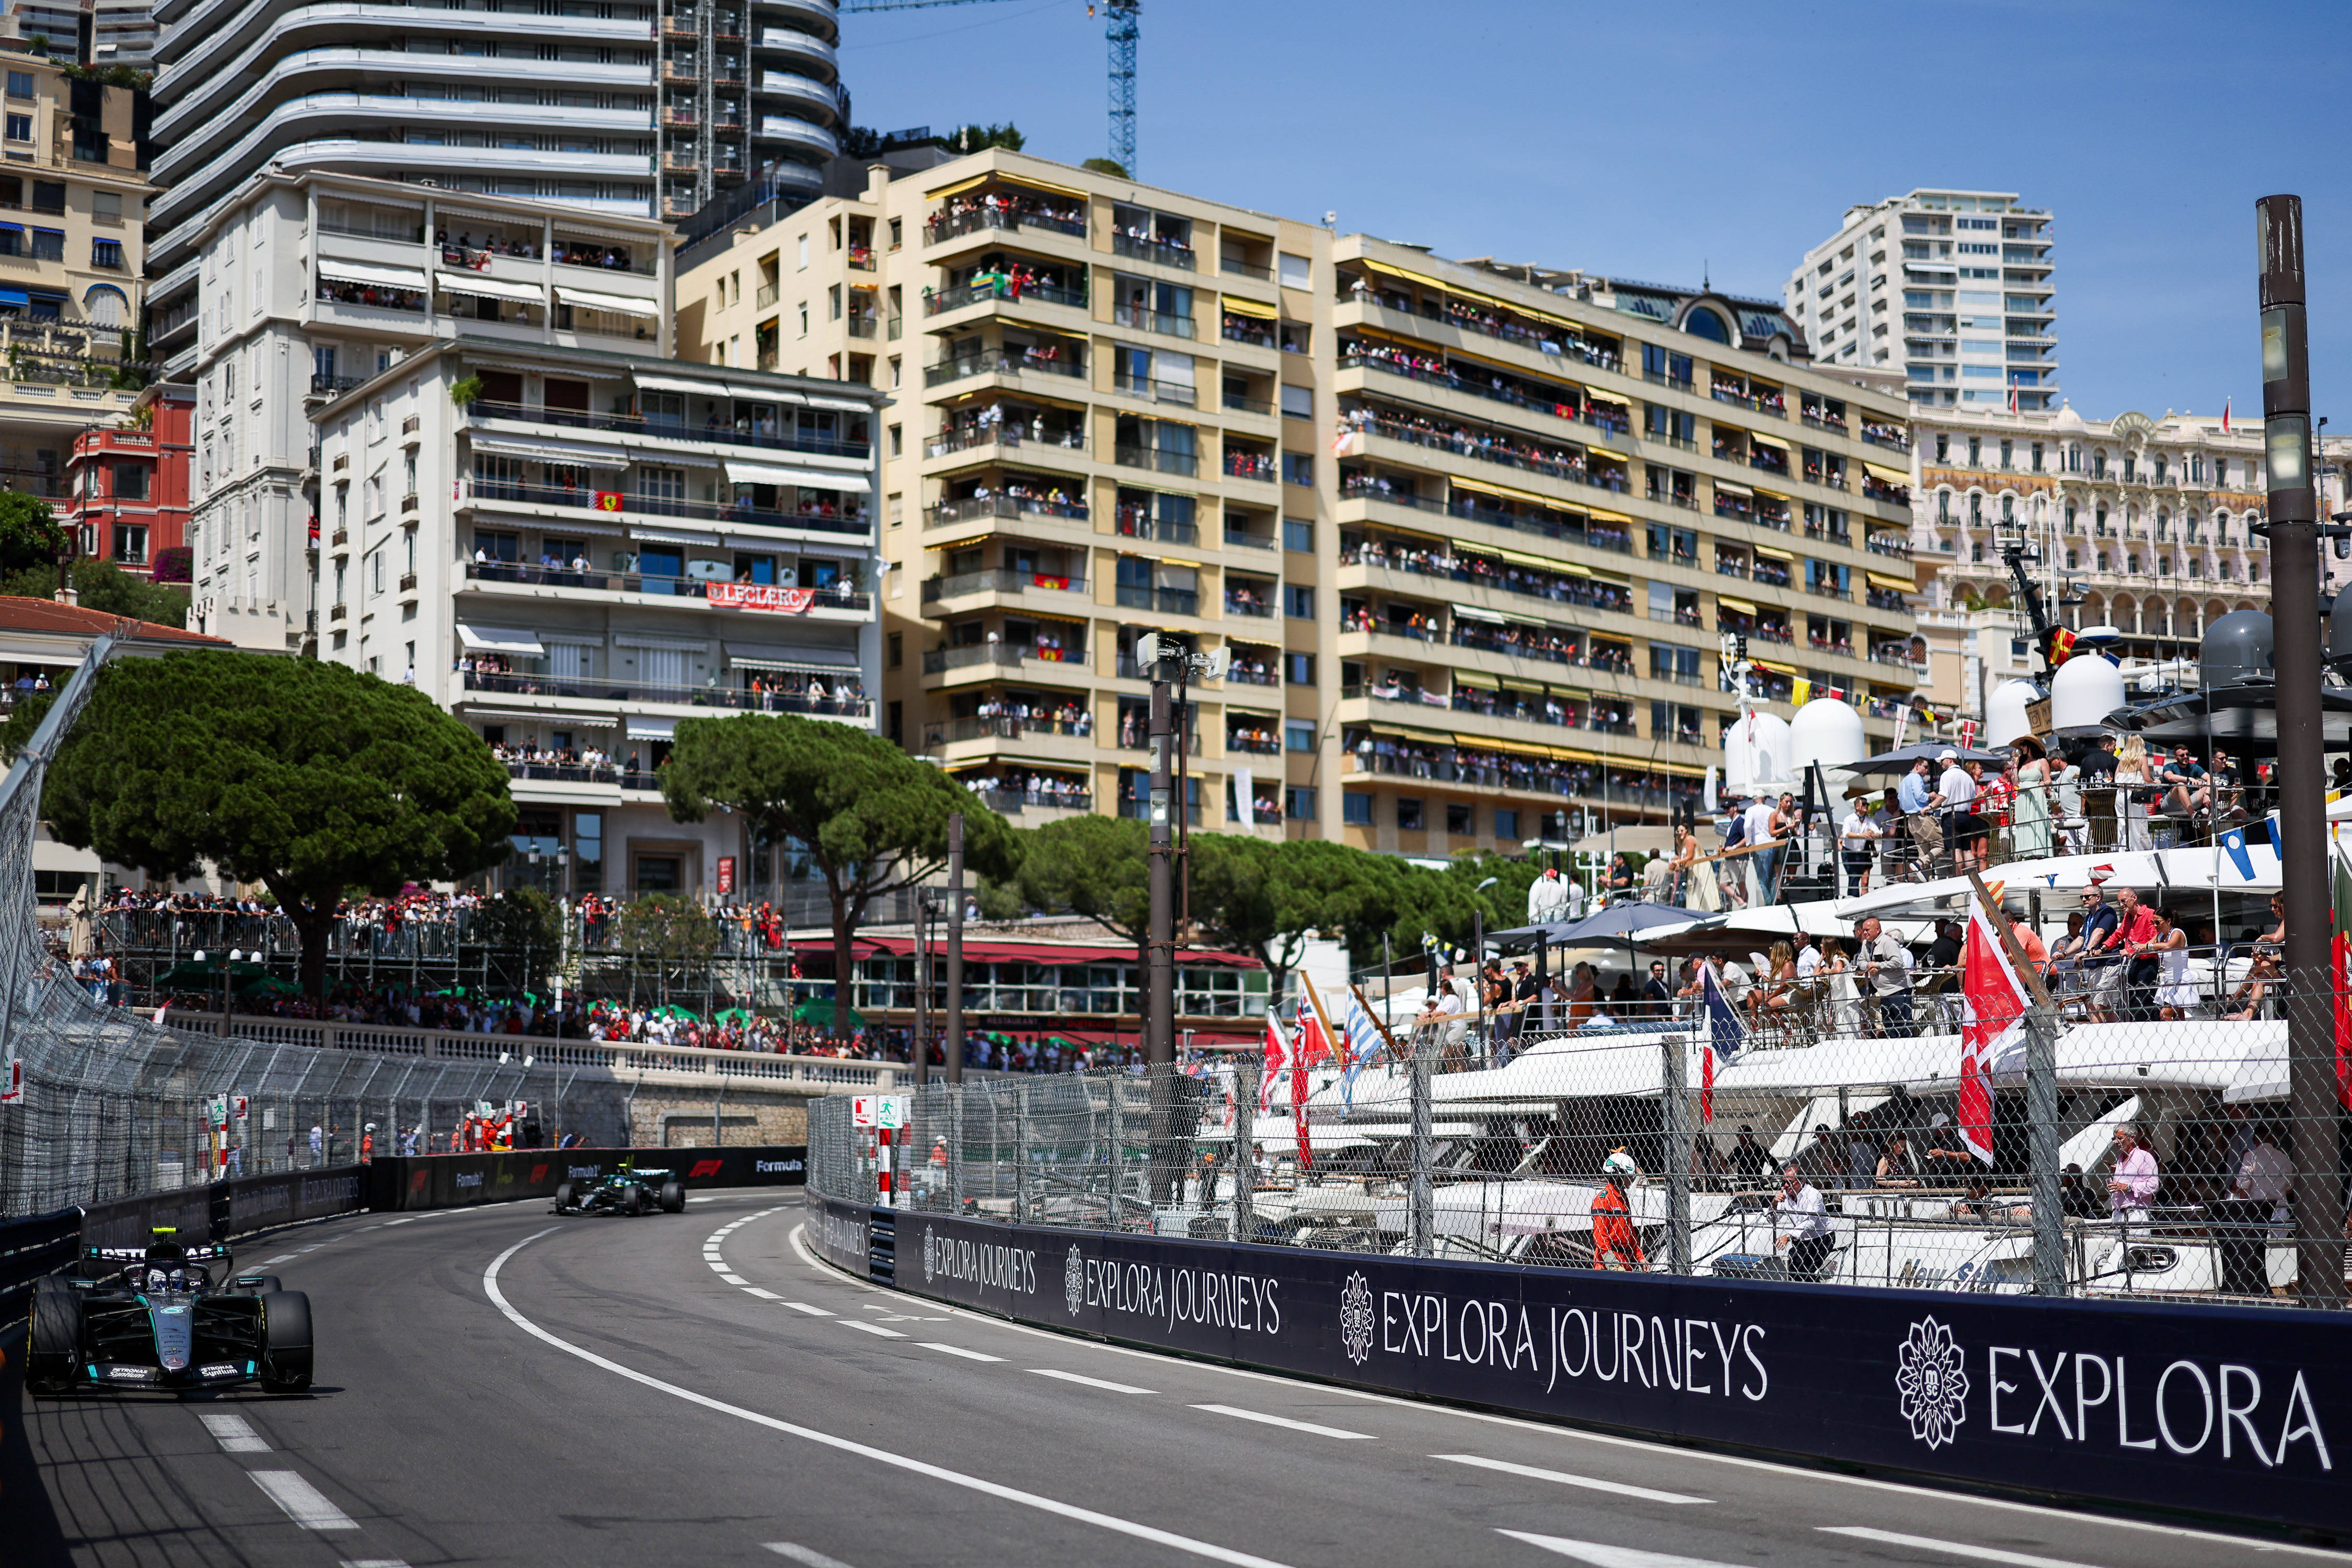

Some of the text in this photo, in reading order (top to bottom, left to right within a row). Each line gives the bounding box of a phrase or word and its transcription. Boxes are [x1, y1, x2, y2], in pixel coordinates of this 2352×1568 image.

[723, 584, 800, 606] LECLERC
[756, 1159, 802, 1172] Formula
[936, 1236, 1035, 1295] EXPLORA JOURNEYS
[1896, 1259, 2007, 1294] New Star
[1087, 1259, 1279, 1334] EXPLORA JOURNEYS
[1383, 1292, 1767, 1401] EXPLORA JOURNEYS
[1989, 1346, 2332, 1471] EXPLORA
